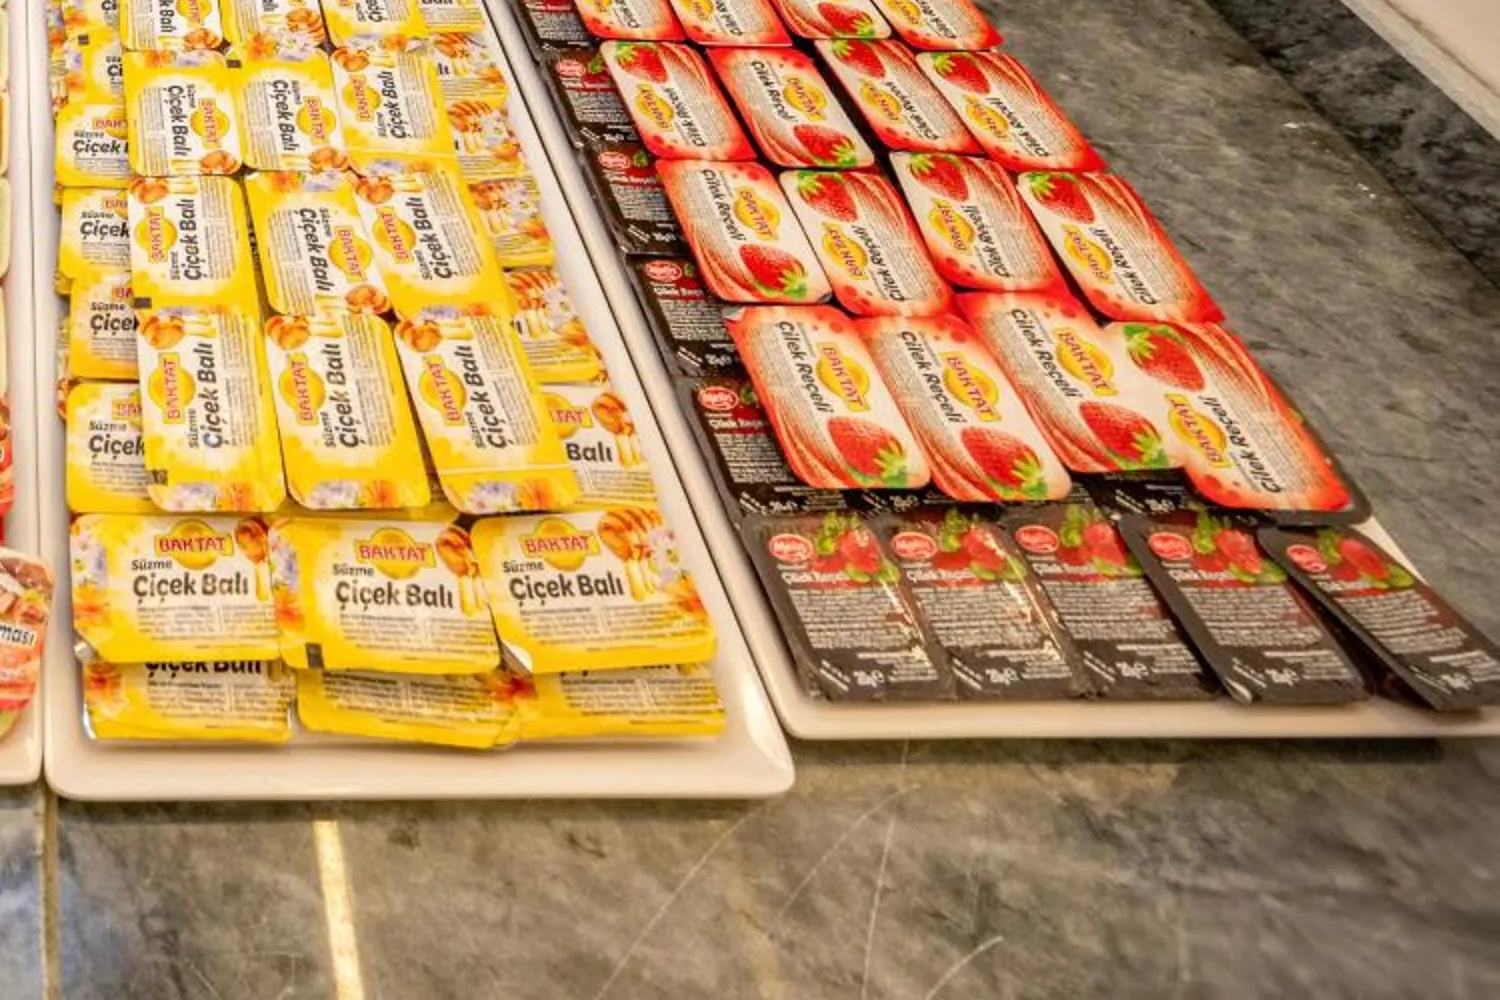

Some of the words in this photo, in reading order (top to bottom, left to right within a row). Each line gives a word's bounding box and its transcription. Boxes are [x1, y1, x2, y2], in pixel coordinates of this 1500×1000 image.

[73, 140, 121, 157] Çiçek
[297, 207, 326, 252] Çiçek
[405, 196, 433, 230] Balı
[310, 255, 335, 291] Balı
[419, 232, 457, 280] Çiçek
[196, 342, 217, 383] Balı
[323, 343, 347, 386] Balı
[454, 345, 484, 388] Balı
[775, 320, 808, 361] Çilek
[794, 362, 834, 413] Reçeli
[1006, 307, 1045, 348] Çilek
[1033, 349, 1082, 398] Reçeli
[164, 360, 179, 419] BAKTAT
[291, 360, 313, 421] BAKTAT
[896, 330, 933, 371] Çilek
[921, 372, 964, 424] Reçeli
[200, 388, 230, 448] Çiçek
[332, 390, 365, 447] Çiçek
[471, 388, 513, 449] Çiçek
[1198, 396, 1251, 449] Reçeli
[565, 443, 613, 463] Balı
[1239, 450, 1286, 494] Çilek
[132, 559, 172, 571] Süzme
[160, 538, 226, 552] BAKTAT
[359, 546, 427, 562] BAKTAT
[525, 536, 590, 553] BAKTAT
[134, 574, 196, 603] Çiçek
[201, 573, 248, 596] Balı
[333, 564, 374, 578] Süzme
[503, 562, 544, 573] Süzme
[336, 580, 401, 611] Çiçek
[406, 583, 453, 607] Balı
[510, 574, 573, 607] Çiçek
[577, 571, 624, 597] Balı
